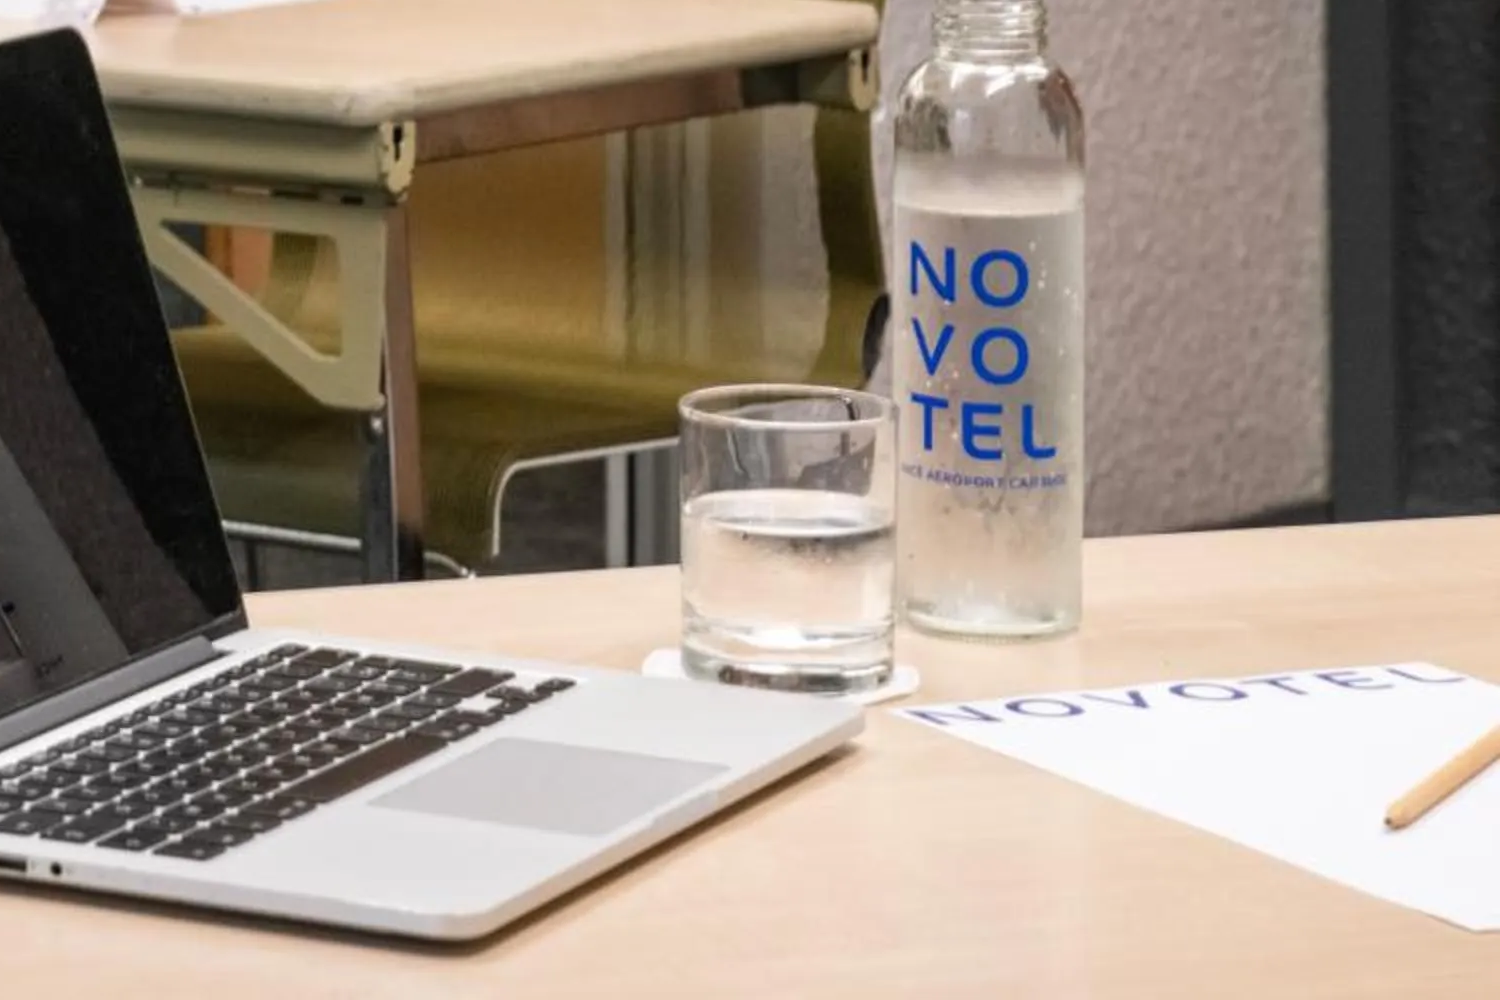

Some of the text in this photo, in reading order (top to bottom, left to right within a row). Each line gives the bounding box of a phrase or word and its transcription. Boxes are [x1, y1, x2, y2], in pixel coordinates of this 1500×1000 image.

[909, 241, 1030, 309] NO
[910, 316, 1030, 387] VO
[909, 391, 1059, 461] TEL
[904, 666, 1468, 726] NOVOTEL
